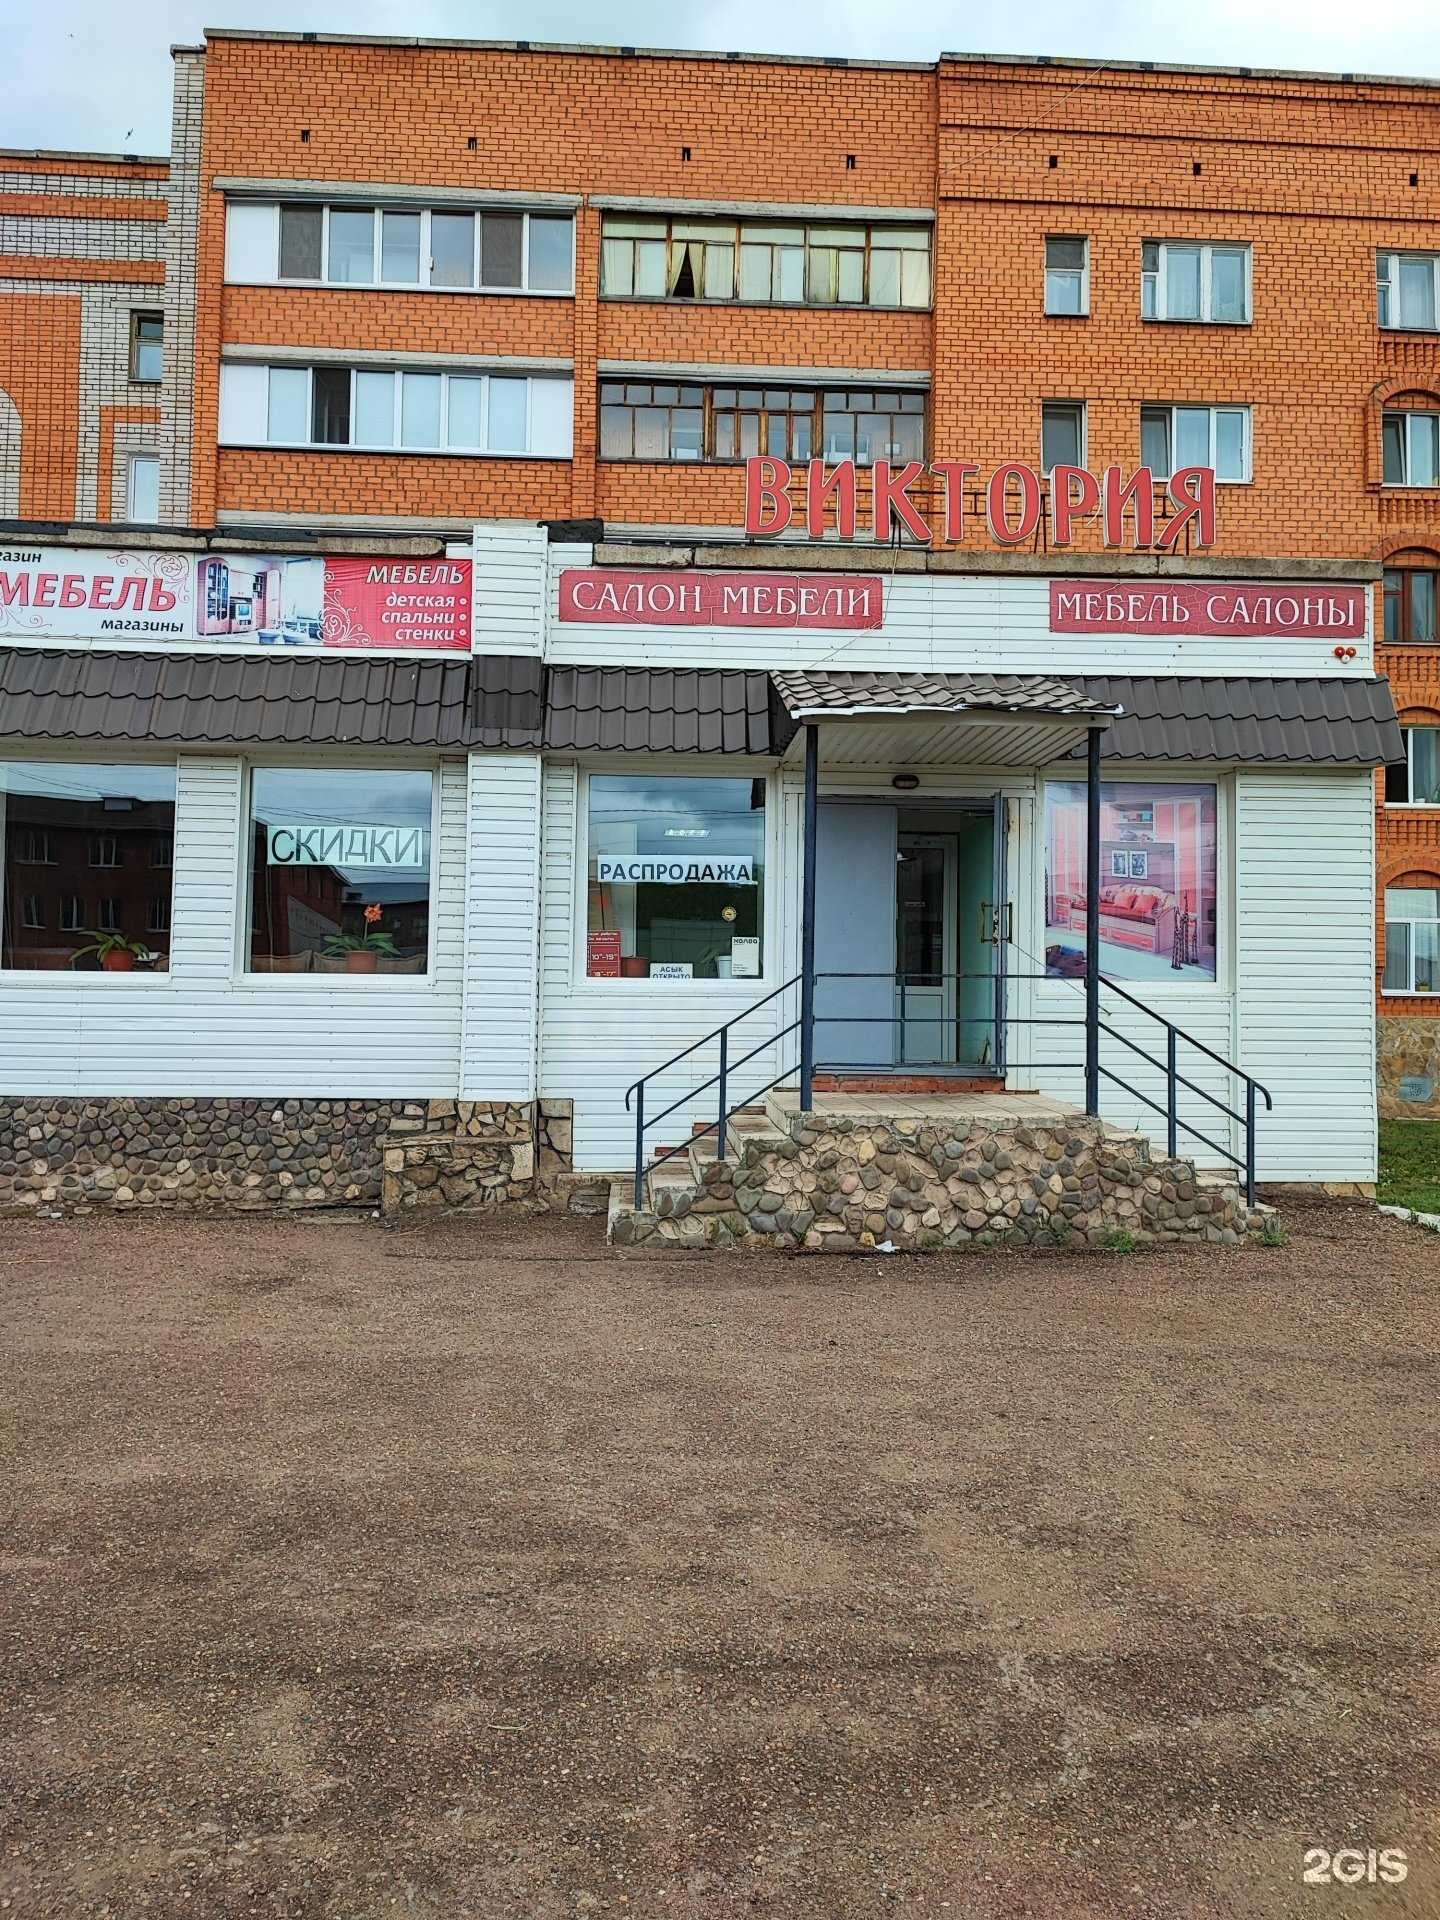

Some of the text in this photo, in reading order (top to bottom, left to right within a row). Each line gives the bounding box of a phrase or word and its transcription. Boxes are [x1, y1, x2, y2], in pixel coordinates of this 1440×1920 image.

[744, 455, 1217, 548] ВИКТОРИЯ
[366, 565, 464, 585] МЕБЕЛЬ
[0, 571, 177, 612] МЕБЕЛЬ
[385, 591, 456, 608] детская
[571, 580, 872, 618] САЛОН МЕБЕЛИ
[381, 611, 456, 624] спальни
[1056, 592, 1356, 628] МЕБЕЛЬ САЛОНЫ
[100, 618, 184, 633] магазины
[395, 628, 456, 641] стенки
[271, 827, 420, 864] СКИДКИ
[600, 863, 751, 882] РАСПРОДАЖА
